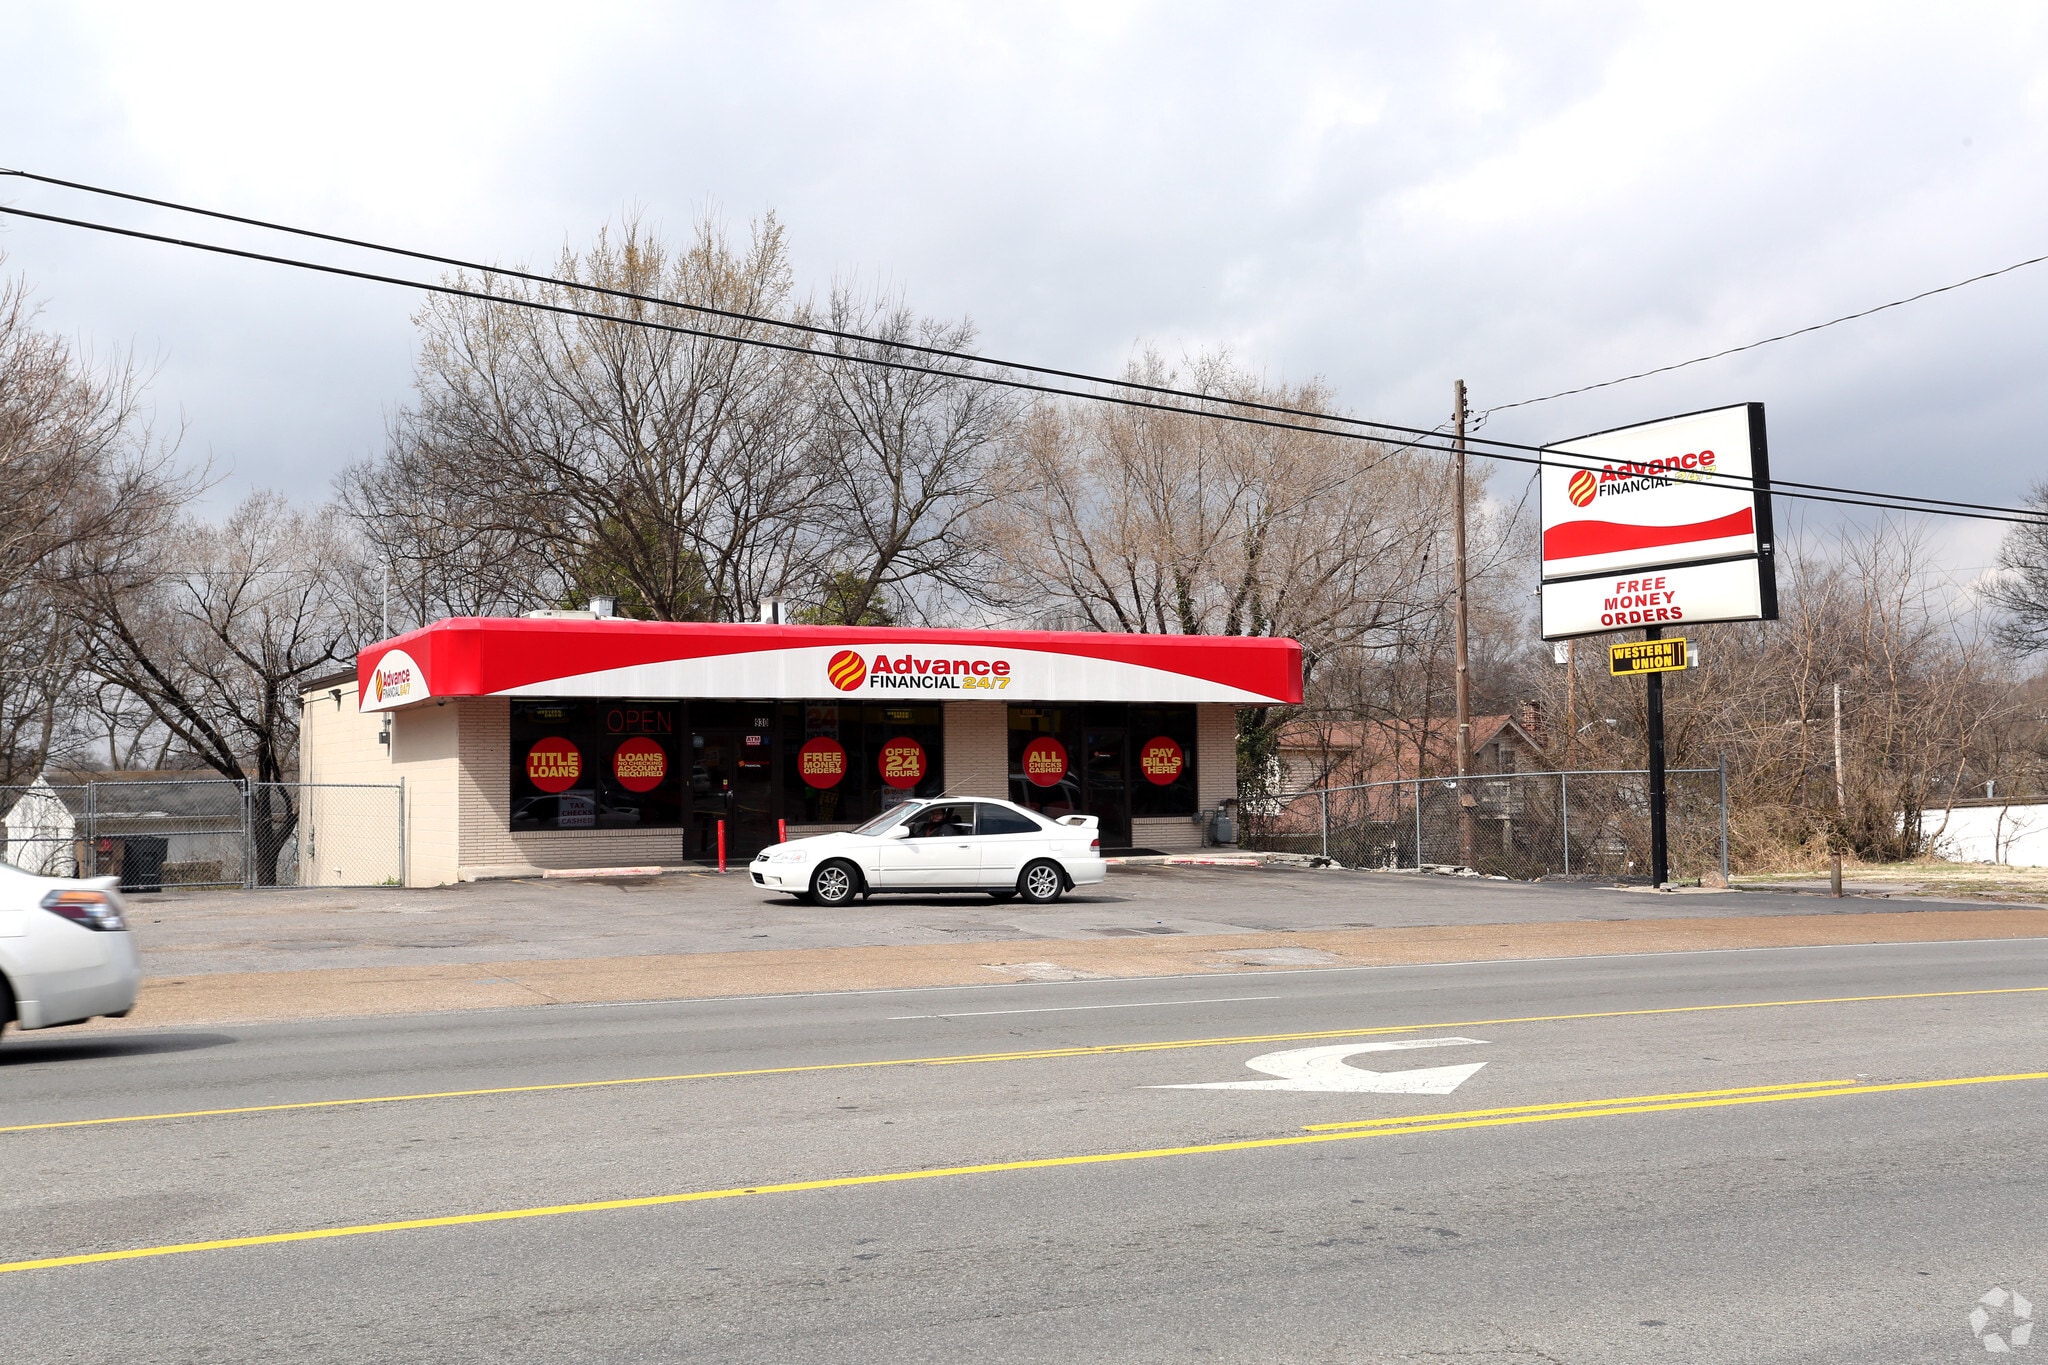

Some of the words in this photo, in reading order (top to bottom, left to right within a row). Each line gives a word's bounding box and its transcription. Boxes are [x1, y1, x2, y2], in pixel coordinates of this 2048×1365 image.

[1599, 449, 1715, 484] Advance
[1599, 474, 1673, 497] FINANCIAL
[1616, 576, 1666, 594] FREE
[1604, 590, 1676, 611] MONEY
[1600, 606, 1683, 627] ORDERS
[1613, 643, 1672, 660] WESTERN
[870, 654, 1011, 676] Advance
[1632, 655, 1673, 670] UNION
[382, 668, 411, 688] Advance
[870, 675, 960, 689] FINANCIAL
[962, 676, 1011, 690] 24/7
[607, 709, 672, 733] OPEN
[529, 752, 579, 766] TITLE
[618, 753, 663, 762] LOANS
[803, 752, 842, 762] FREE
[885, 748, 919, 756] OPEN
[1029, 751, 1062, 763] ALL
[1150, 748, 1174, 757] PAY
[803, 761, 842, 769] MONEY
[885, 755, 919, 771] 24
[1143, 757, 1181, 767] BILLS
[529, 765, 579, 778] LOANS
[1147, 766, 1177, 774] HERE
[561, 809, 593, 817] CHECKS
[561, 817, 593, 825] CASHED
